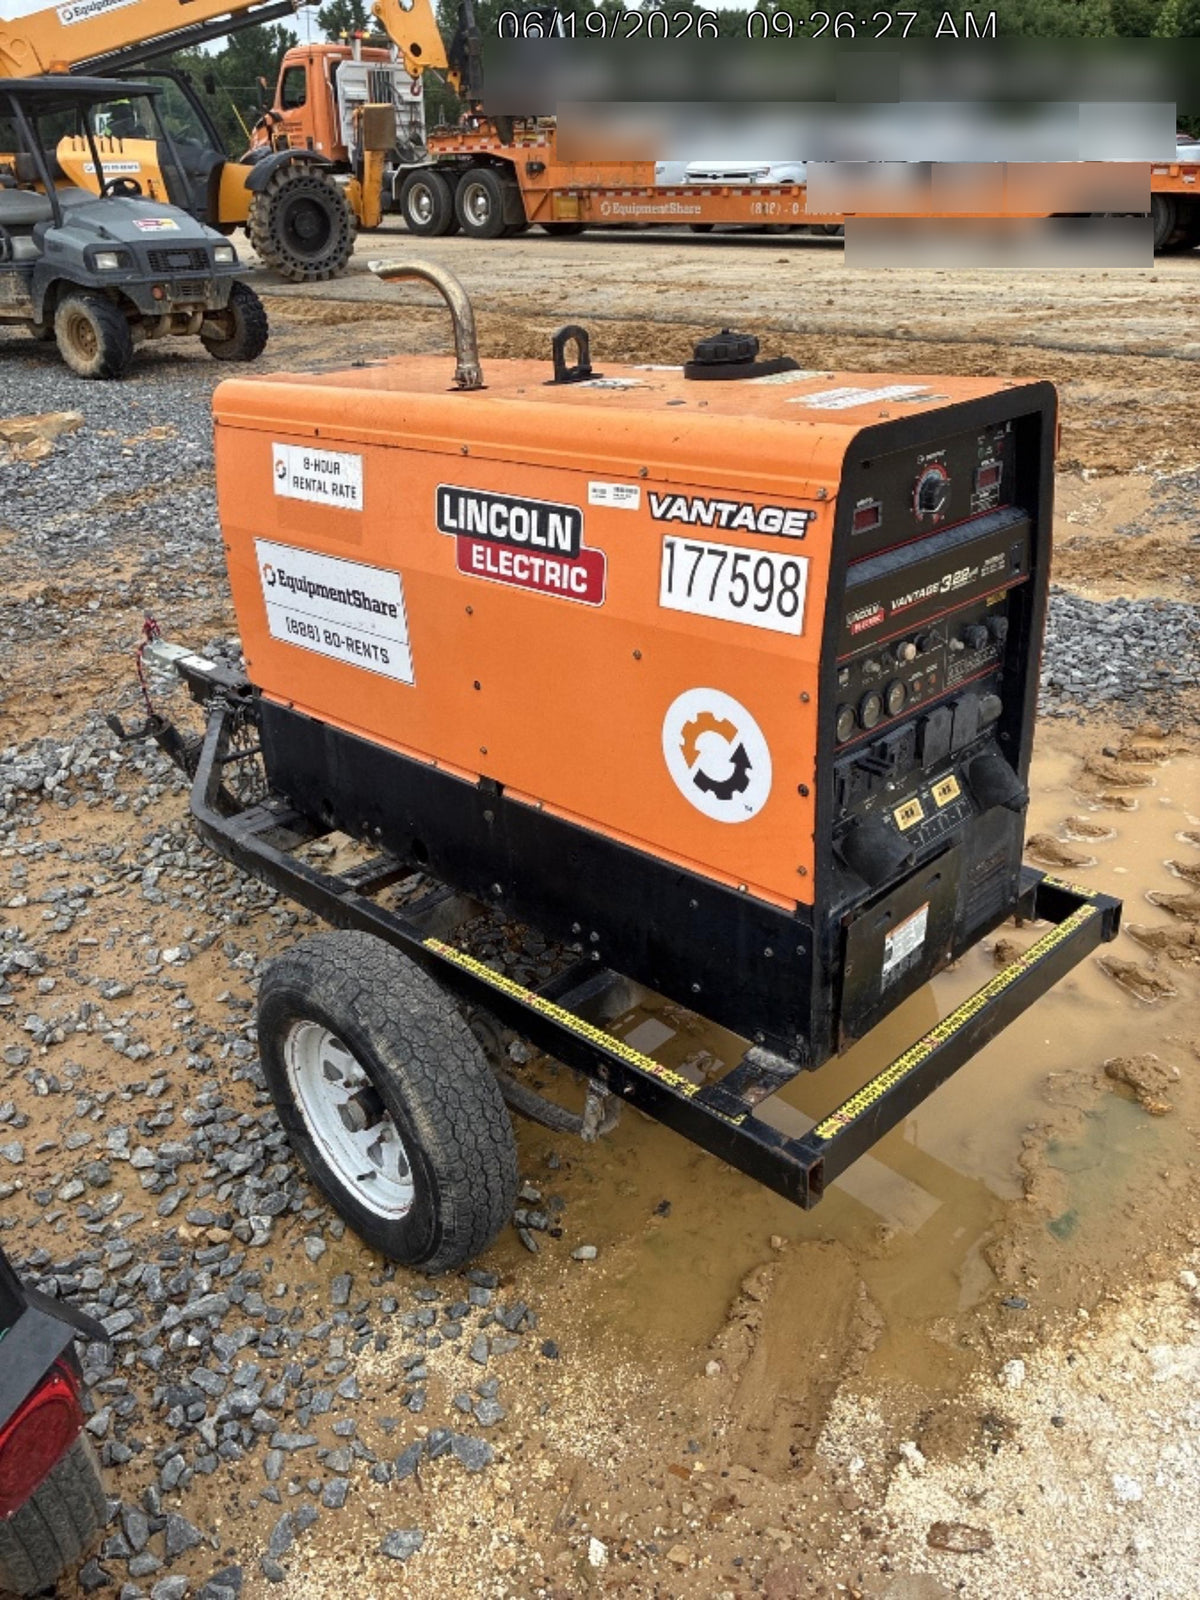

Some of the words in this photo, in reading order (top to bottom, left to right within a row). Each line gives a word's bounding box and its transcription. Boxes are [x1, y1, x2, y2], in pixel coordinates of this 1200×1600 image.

[612, 202, 701, 216] EquipmentShare
[292, 475, 329, 495] RENTAL
[331, 482, 357, 500] RATE
[303, 457, 341, 476] 8-HOUR
[442, 494, 573, 552] LINCOLN
[648, 492, 809, 537] VANTAGE
[277, 568, 399, 620] EquipmentShare
[471, 545, 588, 594] ELECTRIC
[664, 540, 801, 617] 177598
[285, 616, 321, 643] (888)
[323, 626, 390, 665] 80-RENTS
